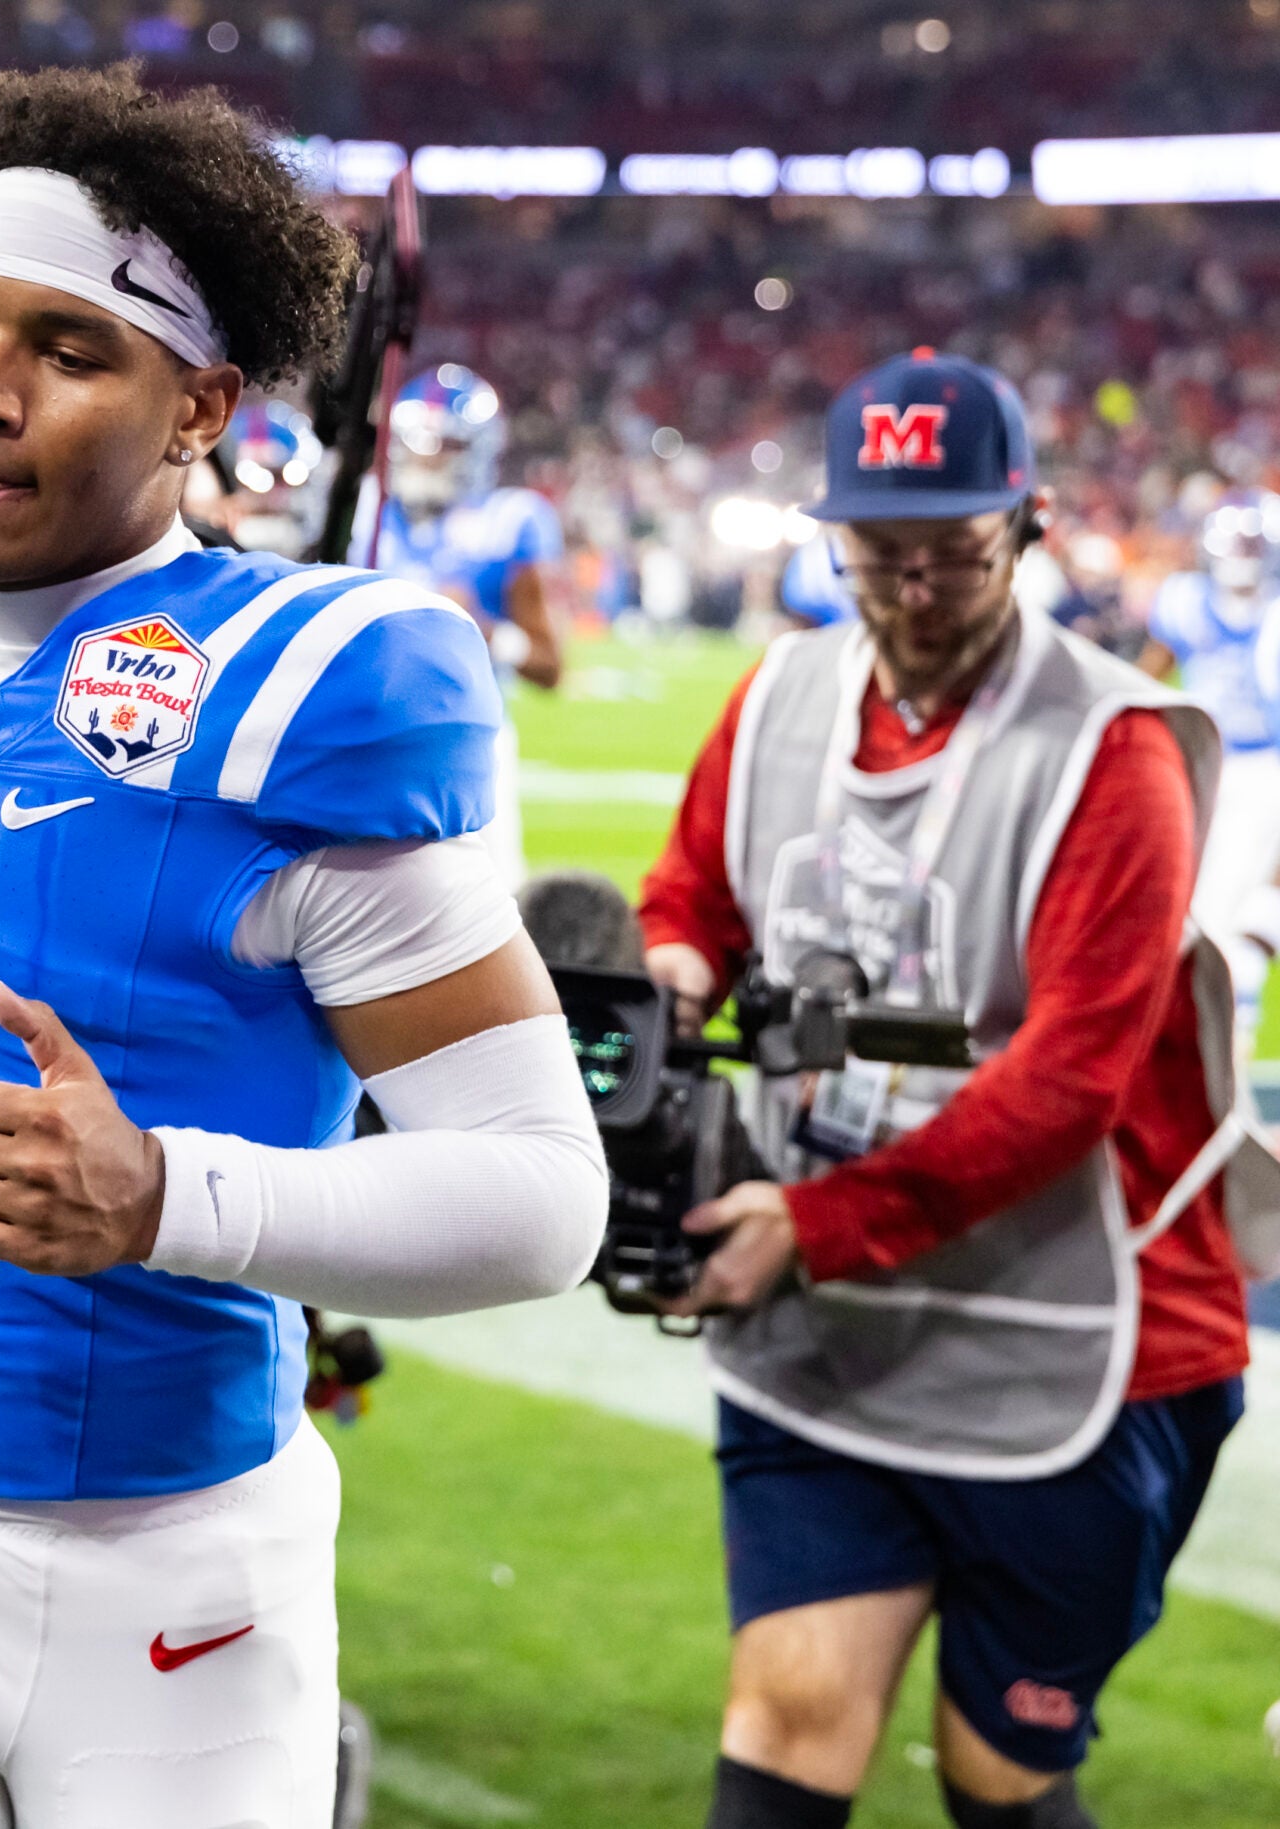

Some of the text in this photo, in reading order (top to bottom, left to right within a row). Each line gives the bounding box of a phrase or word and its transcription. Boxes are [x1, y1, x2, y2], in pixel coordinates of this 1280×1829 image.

[858, 403, 949, 470] M
[106, 649, 176, 681] Vrbo
[69, 677, 192, 715] Fiesta Bowl
